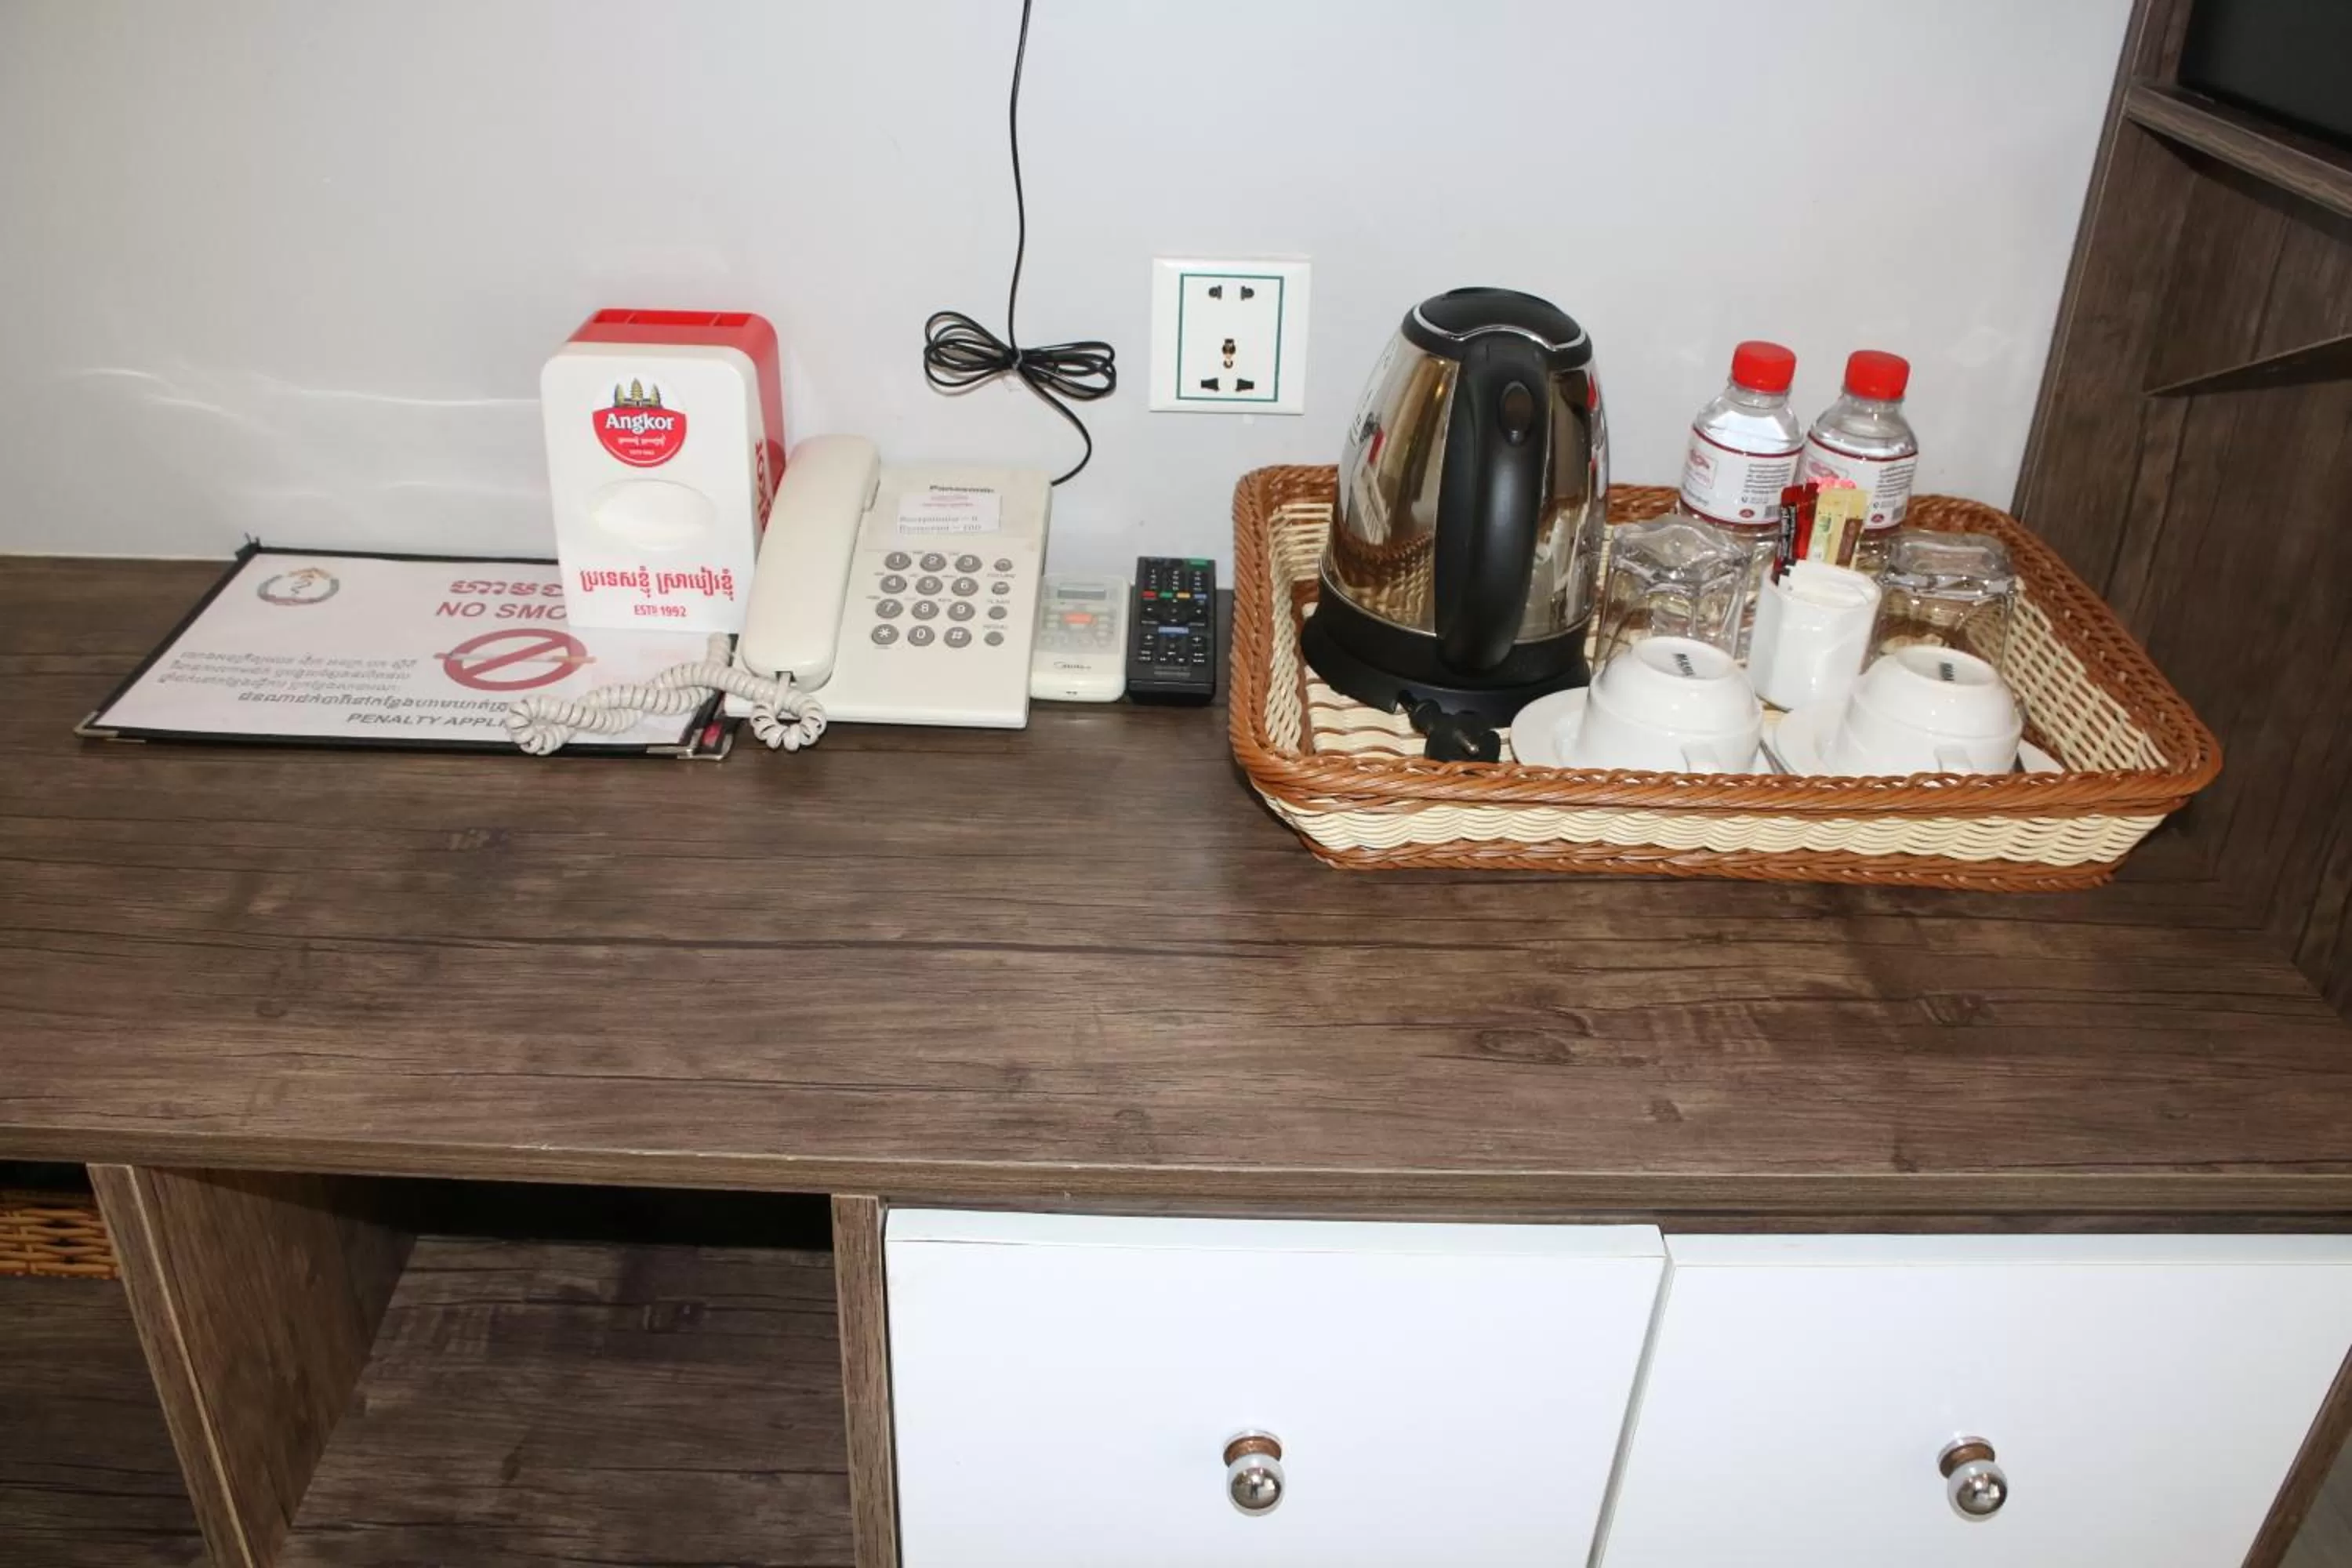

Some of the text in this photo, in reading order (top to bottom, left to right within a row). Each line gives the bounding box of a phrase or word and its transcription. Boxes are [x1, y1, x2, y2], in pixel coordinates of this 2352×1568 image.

[605, 412, 674, 434] Angkor
[887, 577, 896, 587] 4
[435, 601, 486, 617] NO
[660, 605, 687, 617] 1992
[884, 601, 895, 612] 7
[920, 603, 929, 613] 8
[347, 713, 441, 725] PENALTY
